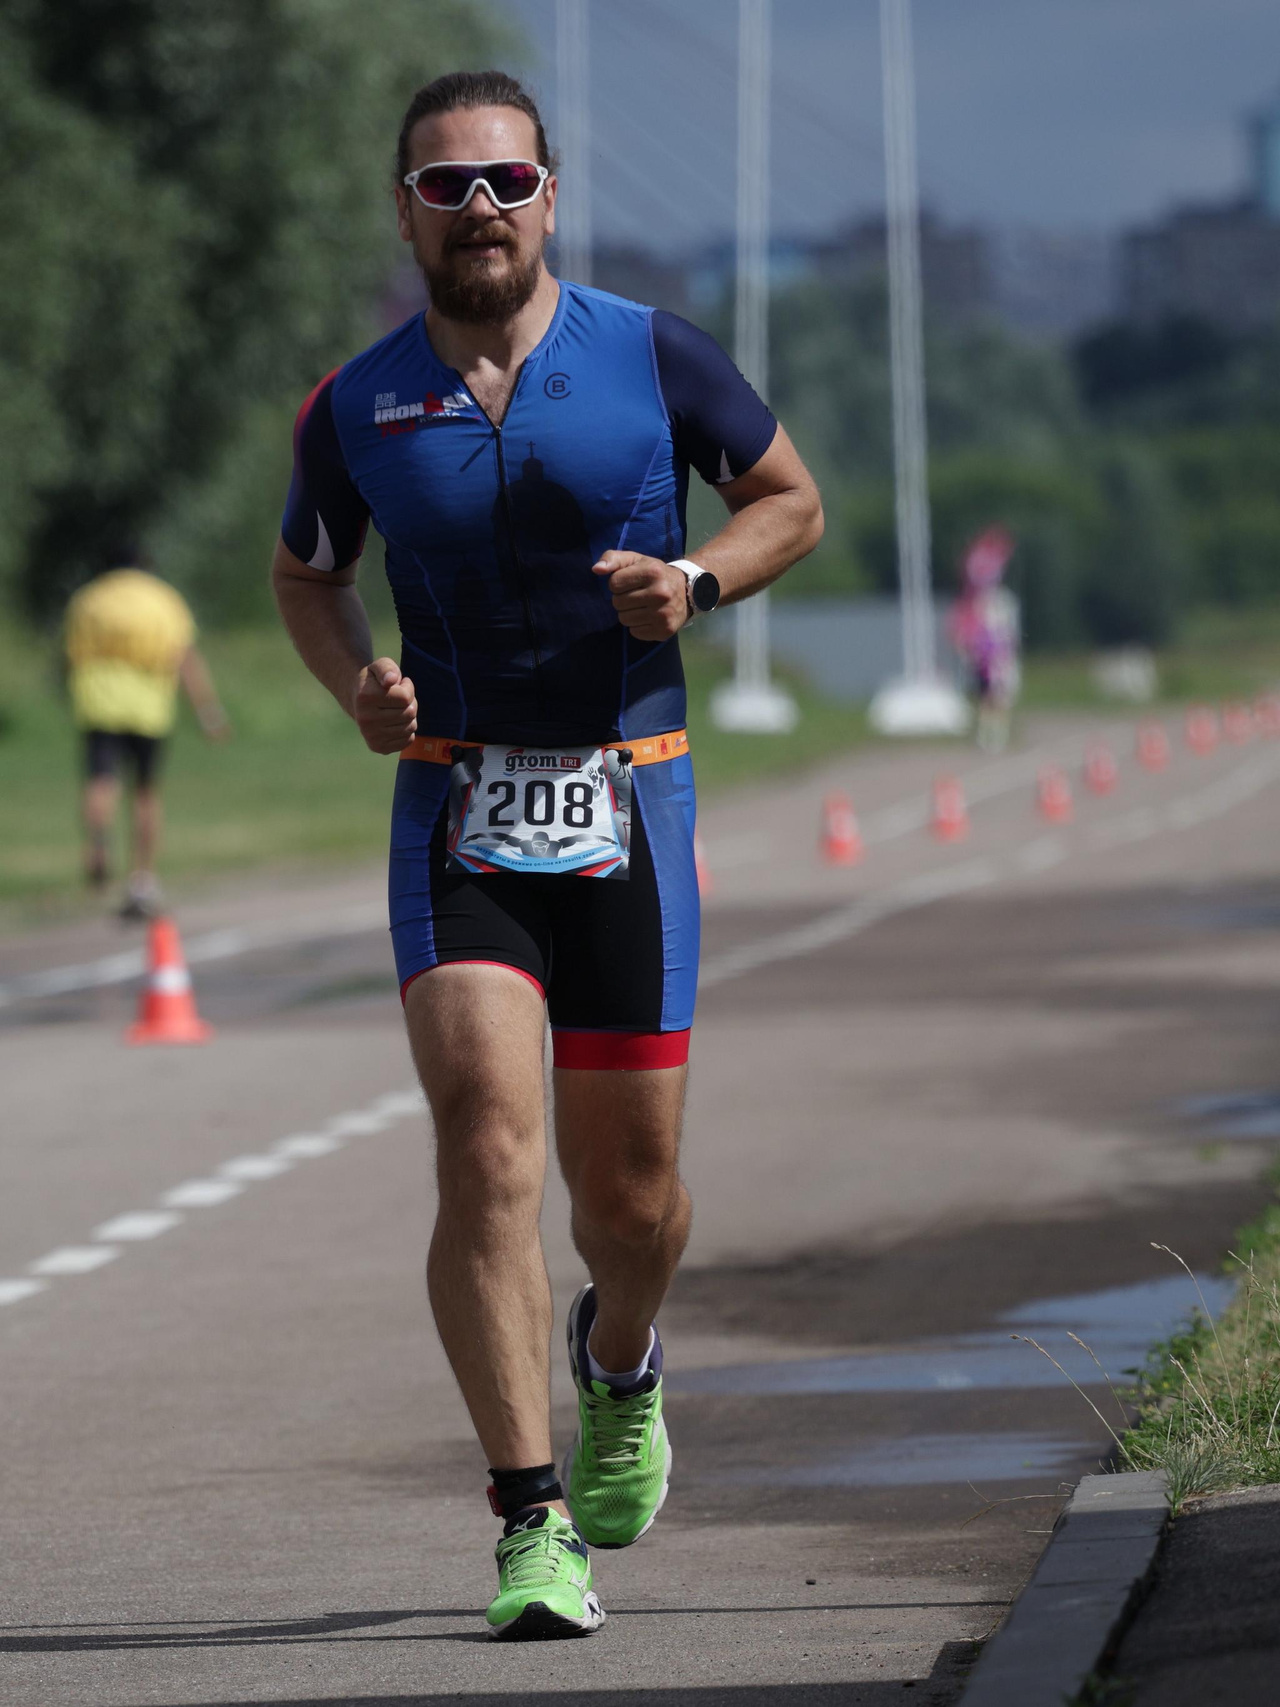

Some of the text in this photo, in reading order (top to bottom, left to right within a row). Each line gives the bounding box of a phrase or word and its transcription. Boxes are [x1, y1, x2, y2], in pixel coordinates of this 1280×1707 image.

[505, 753, 578, 773] grom TRI
[487, 780, 594, 829] 208
